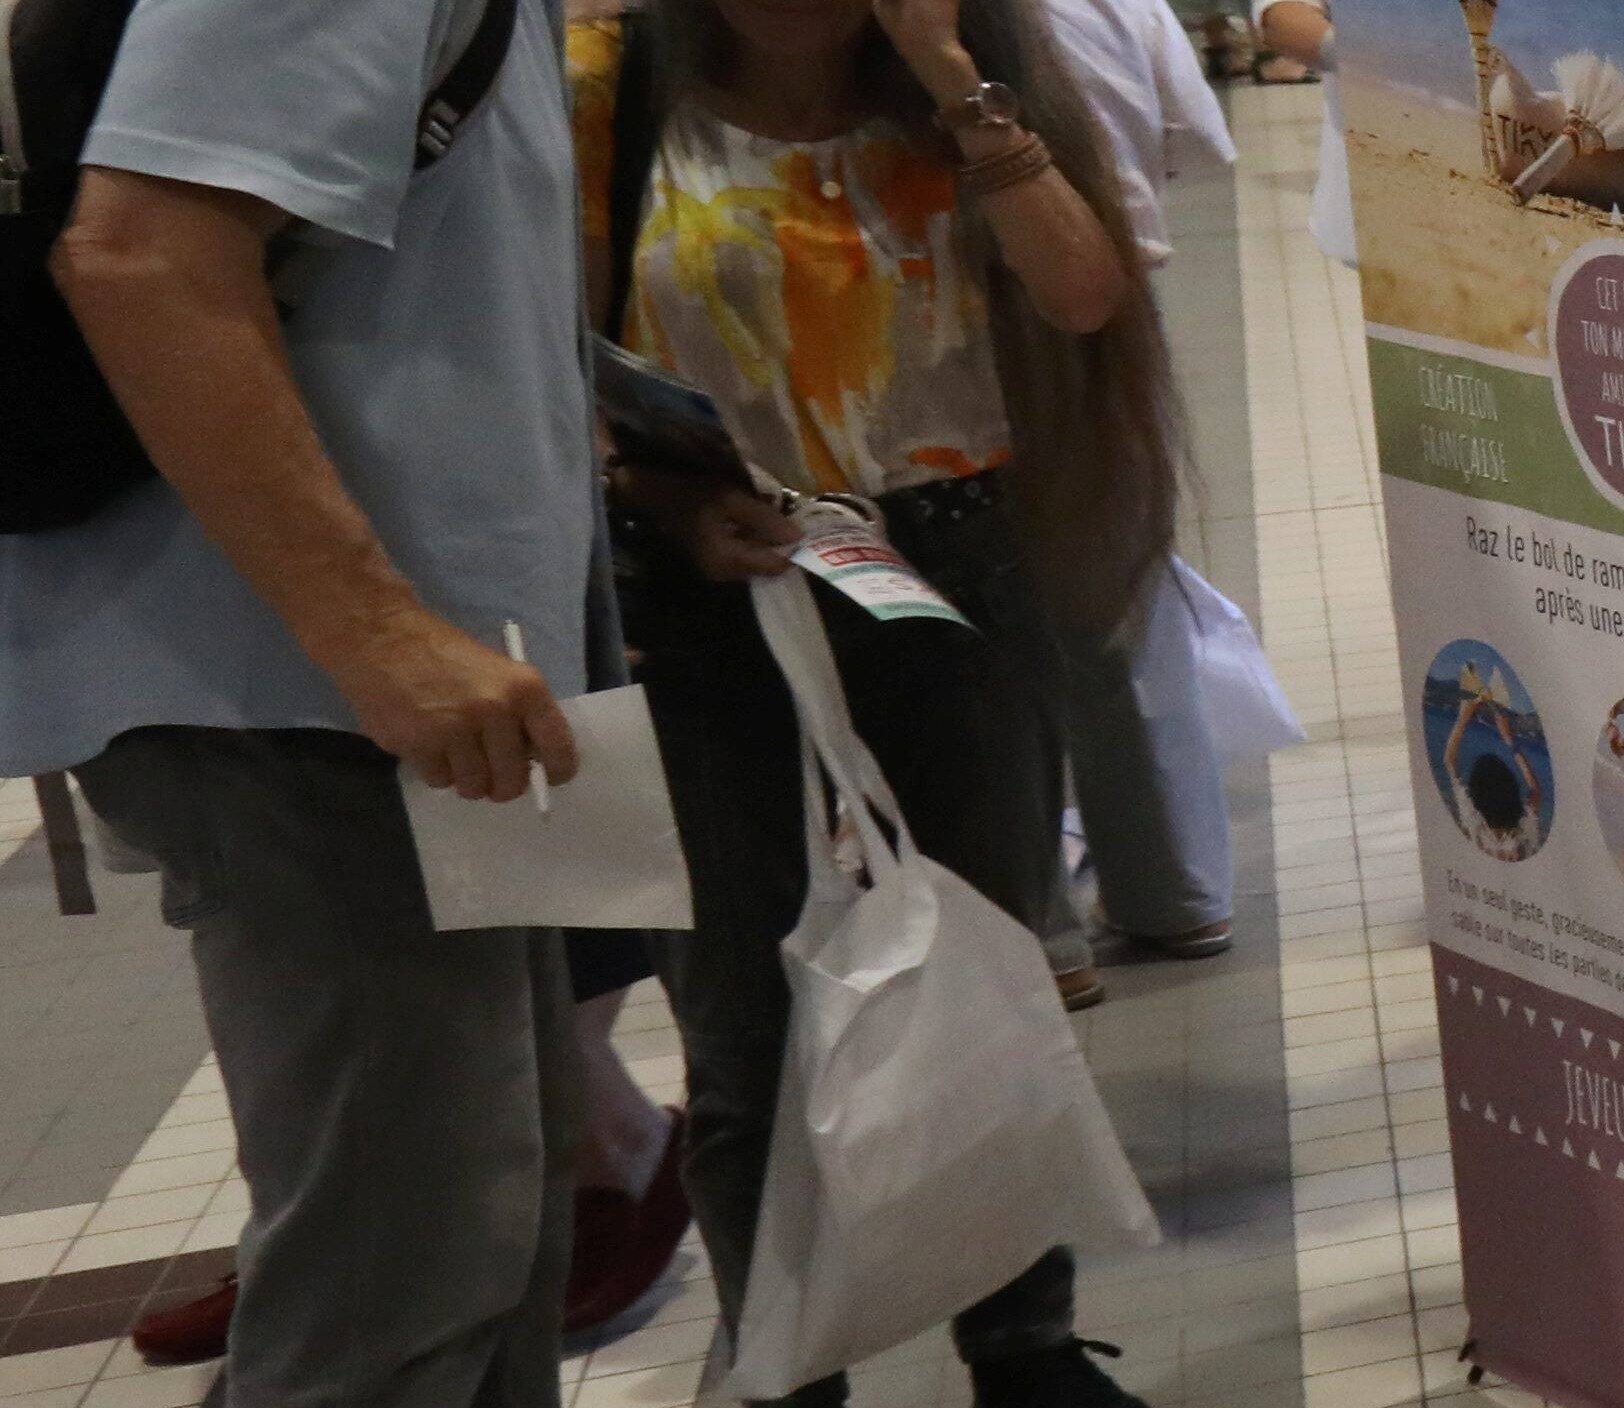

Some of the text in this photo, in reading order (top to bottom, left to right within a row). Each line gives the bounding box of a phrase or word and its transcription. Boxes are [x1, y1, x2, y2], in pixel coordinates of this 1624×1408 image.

[1581, 320, 1610, 357] TON
[1418, 365, 1500, 423] CRÉATION
[1421, 424, 1511, 486] FRANÇAISE
[1466, 515, 1500, 558] Raz
[1505, 523, 1525, 563] le
[1531, 531, 1560, 573] bol
[1563, 540, 1585, 579] de
[1535, 585, 1584, 626] après
[1589, 605, 1624, 638] une
